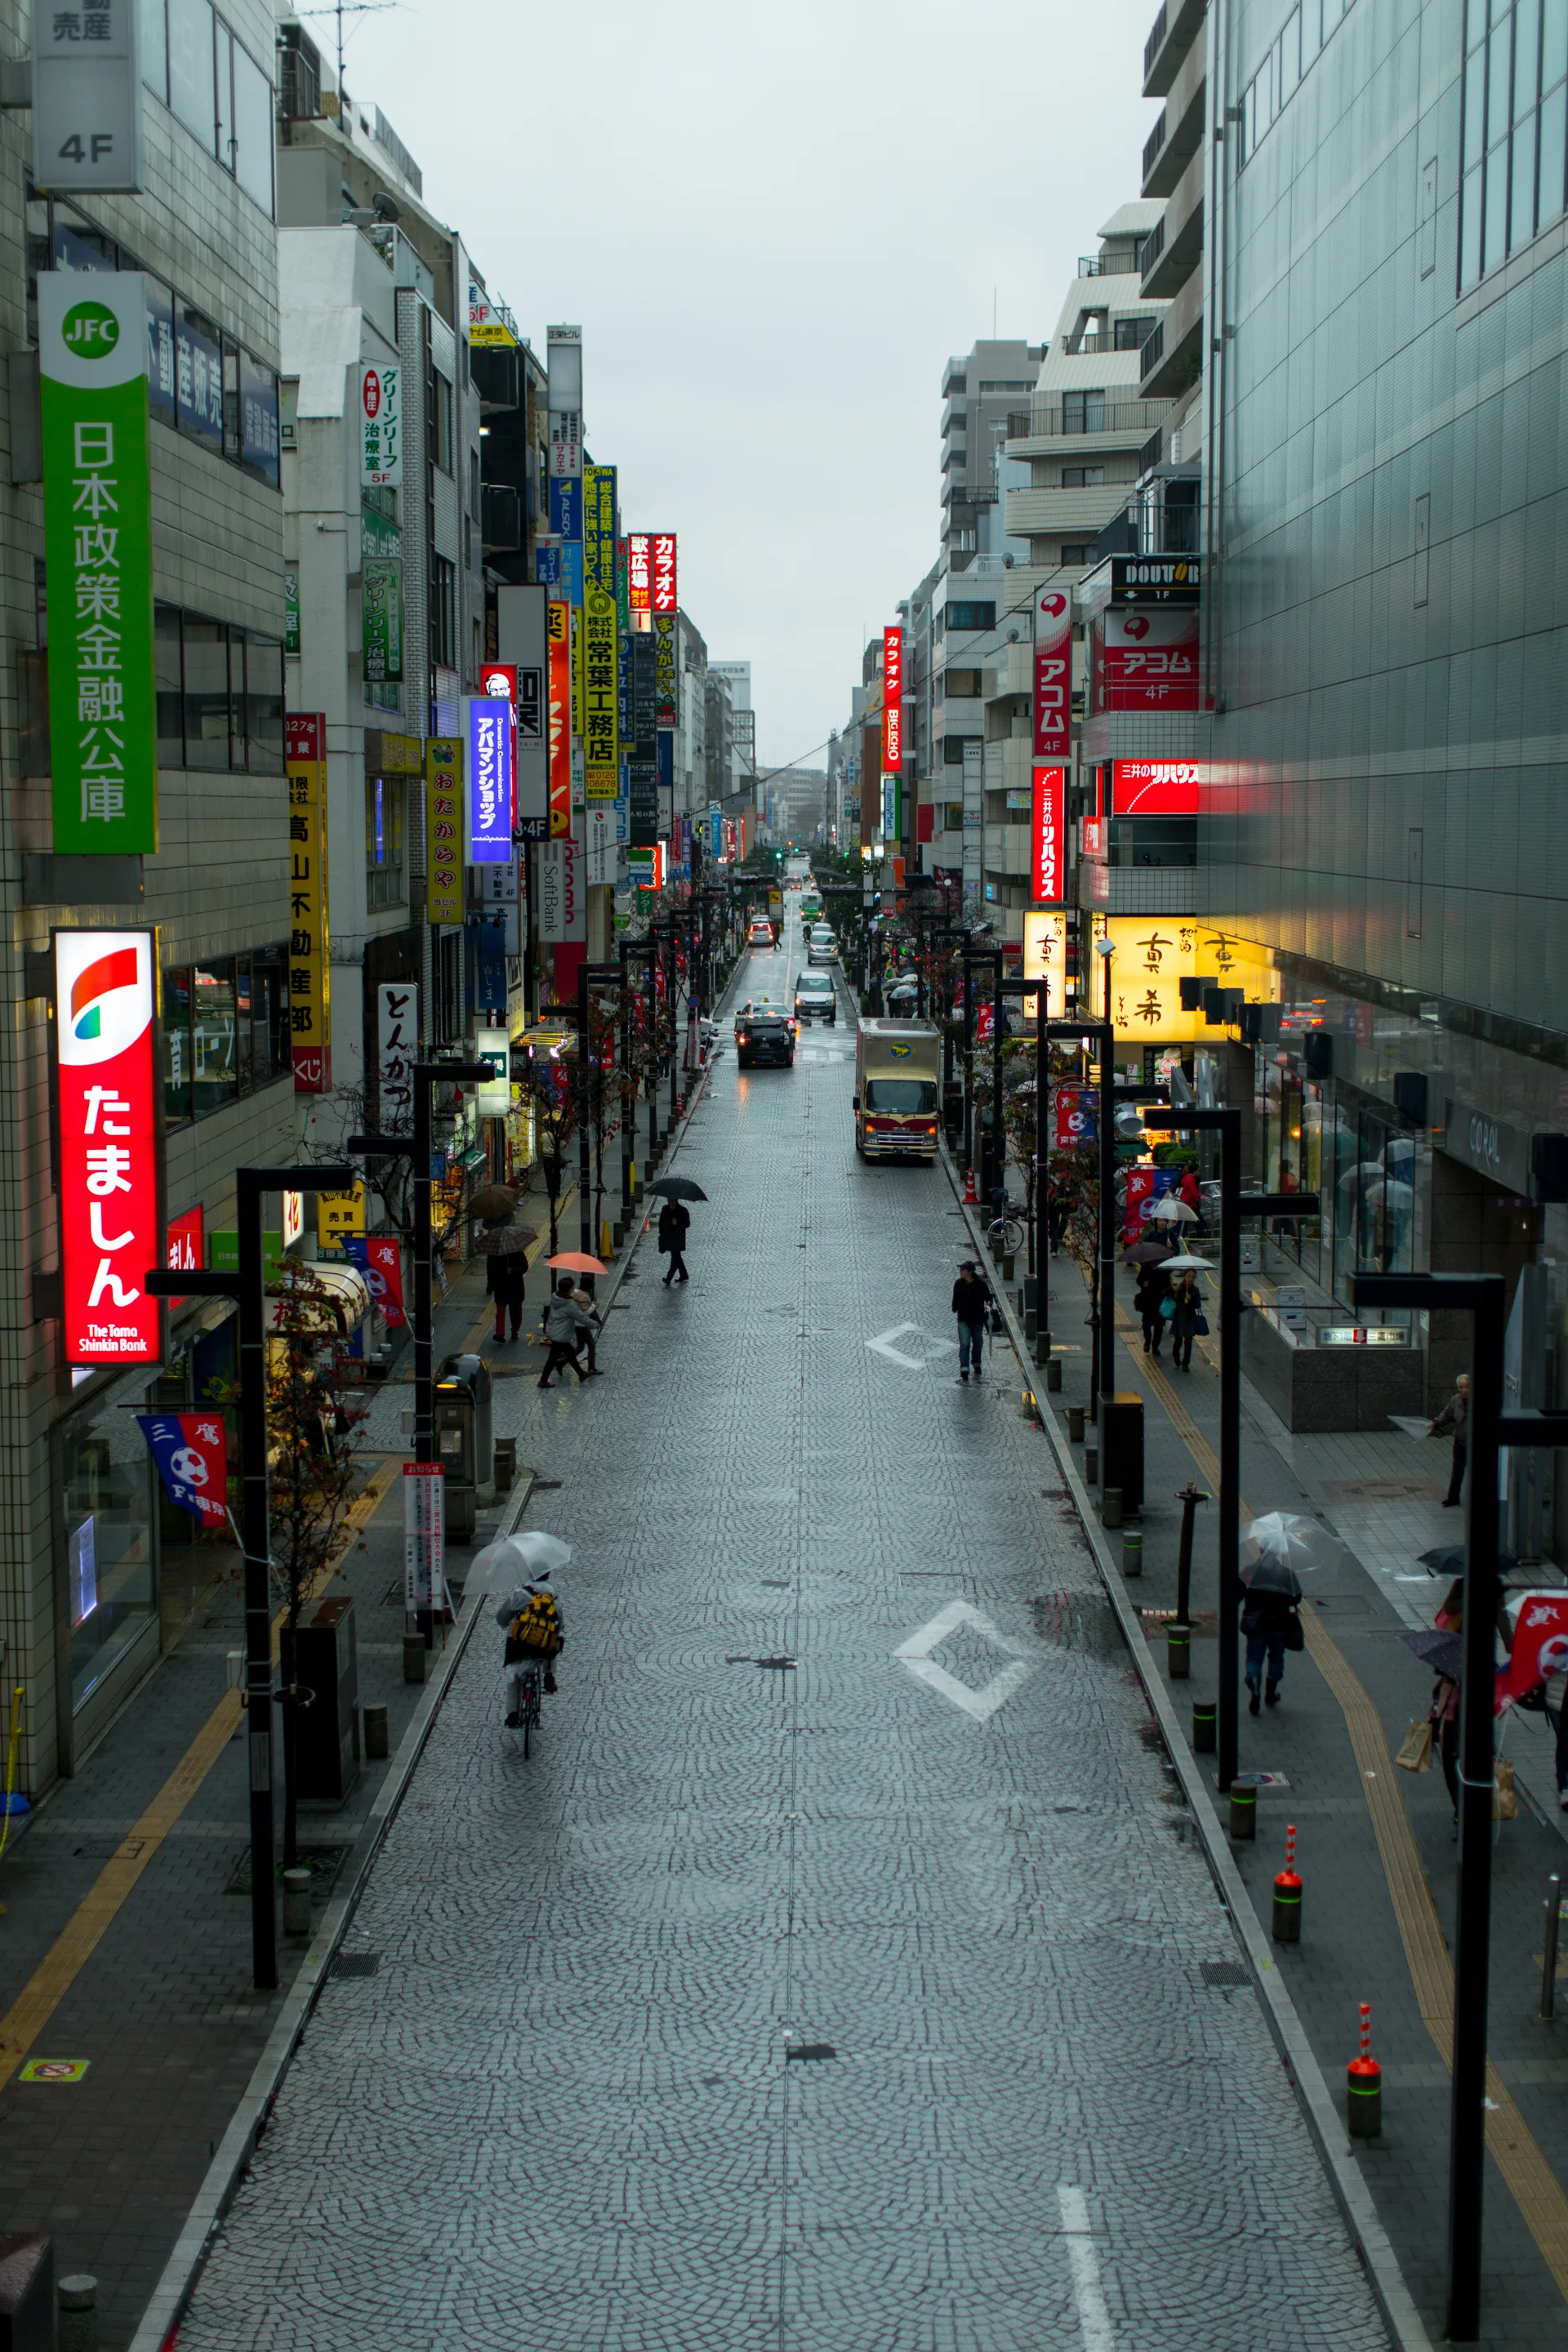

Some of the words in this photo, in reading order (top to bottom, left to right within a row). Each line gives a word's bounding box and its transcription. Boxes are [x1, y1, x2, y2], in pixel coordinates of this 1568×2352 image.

[58, 134, 113, 163] 4F
[65, 318, 115, 342] JFC
[548, 330, 580, 339] 正栄ビル
[382, 370, 399, 468] グリーンリーフ
[365, 423, 380, 470] 治療室
[556, 445, 565, 474] サカエヤ
[372, 473, 390, 483] 5F
[583, 467, 613, 477] TOKIWA
[561, 497, 572, 538] ALSOK
[584, 481, 598, 591] 地震に強い家づくり
[599, 480, 613, 591] 総合建築・健康住宅
[630, 535, 649, 589] 歌広場
[655, 536, 674, 611] カラオケ
[1126, 563, 1200, 584] DOUTOR
[630, 590, 649, 598] 受付
[631, 599, 648, 607] 5F
[1156, 590, 1170, 599] 1F
[73, 421, 126, 822] 日本政策金融公庫
[365, 576, 387, 681] グリーンリーフ治療室
[587, 617, 612, 627] 株式
[587, 627, 612, 638] 会社
[657, 617, 675, 667] まんが
[886, 635, 899, 690] カラオケ
[1123, 652, 1192, 675] アコム
[587, 640, 614, 761] 常葉工務店
[1040, 659, 1066, 733] アコム
[1146, 684, 1169, 699] 4F
[888, 709, 898, 730] BIG
[888, 731, 898, 761] ECHO
[1044, 741, 1061, 751] 4F
[478, 717, 496, 830] アパマンショップ
[596, 771, 616, 779] 0120
[1121, 763, 1199, 785] 三井のリハウス
[886, 788, 894, 831] FamilyMart
[434, 771, 456, 889] おたからや
[1041, 789, 1055, 898] 三井のリハウス
[434, 898, 457, 906] 当ビル
[439, 909, 452, 918] 3F
[544, 866, 559, 933] SoftBank
[290, 815, 313, 1033] 高山不動産部
[384, 991, 411, 1106] とんかつ
[1470, 1115, 1499, 1171] CORAL
[84, 1085, 140, 1307] たましん
[328, 1211, 354, 1222] 売買
[79, 1338, 118, 1352] Shinkin
[119, 1338, 147, 1352] Bank
[87, 1324, 108, 1338] The
[108, 1324, 138, 1338] Tama
[408, 1464, 440, 1473] お知らせ
